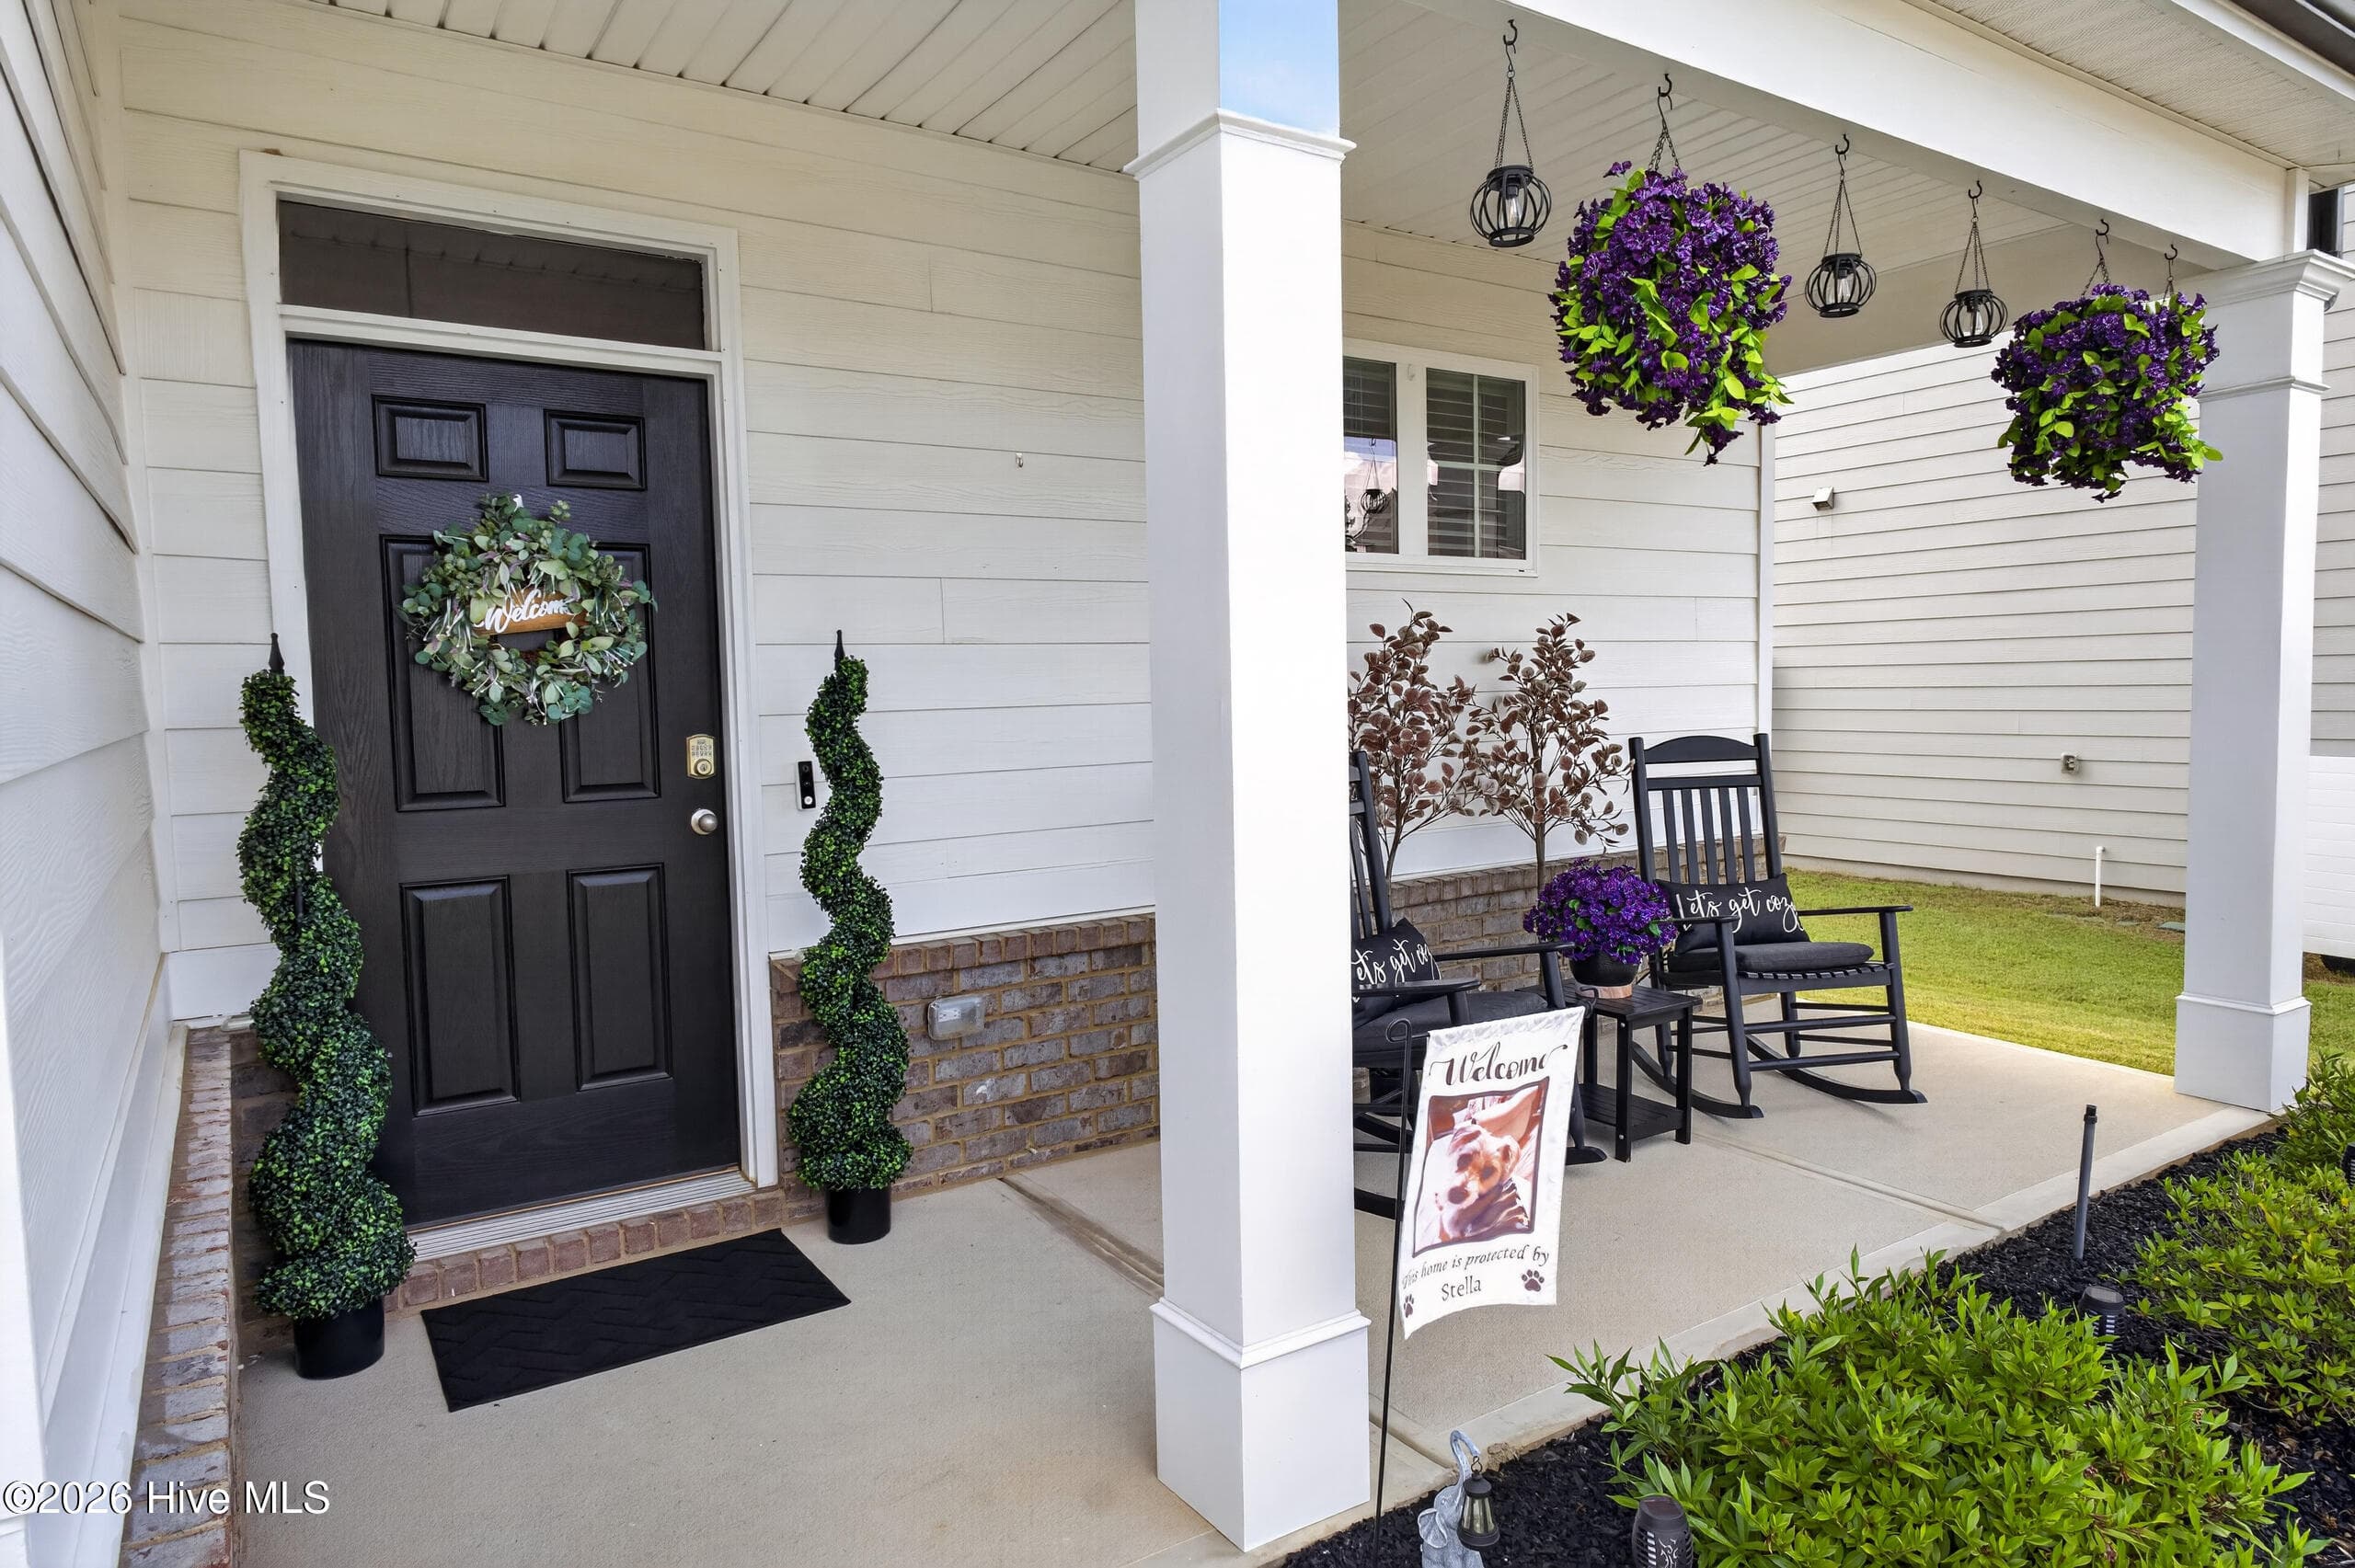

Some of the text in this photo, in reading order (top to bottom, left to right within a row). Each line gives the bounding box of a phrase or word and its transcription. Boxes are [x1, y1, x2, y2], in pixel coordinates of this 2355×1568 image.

[1729, 887, 1762, 933] get
[1351, 948, 1385, 986] et's
[1389, 938, 1417, 987] get
[1429, 1041, 1568, 1086] Welcome
[1420, 1261, 1448, 1278] home
[1452, 1253, 1462, 1269] is
[1465, 1243, 1530, 1270] protected
[1532, 1245, 1549, 1267] by
[1441, 1275, 1482, 1302] Stella
